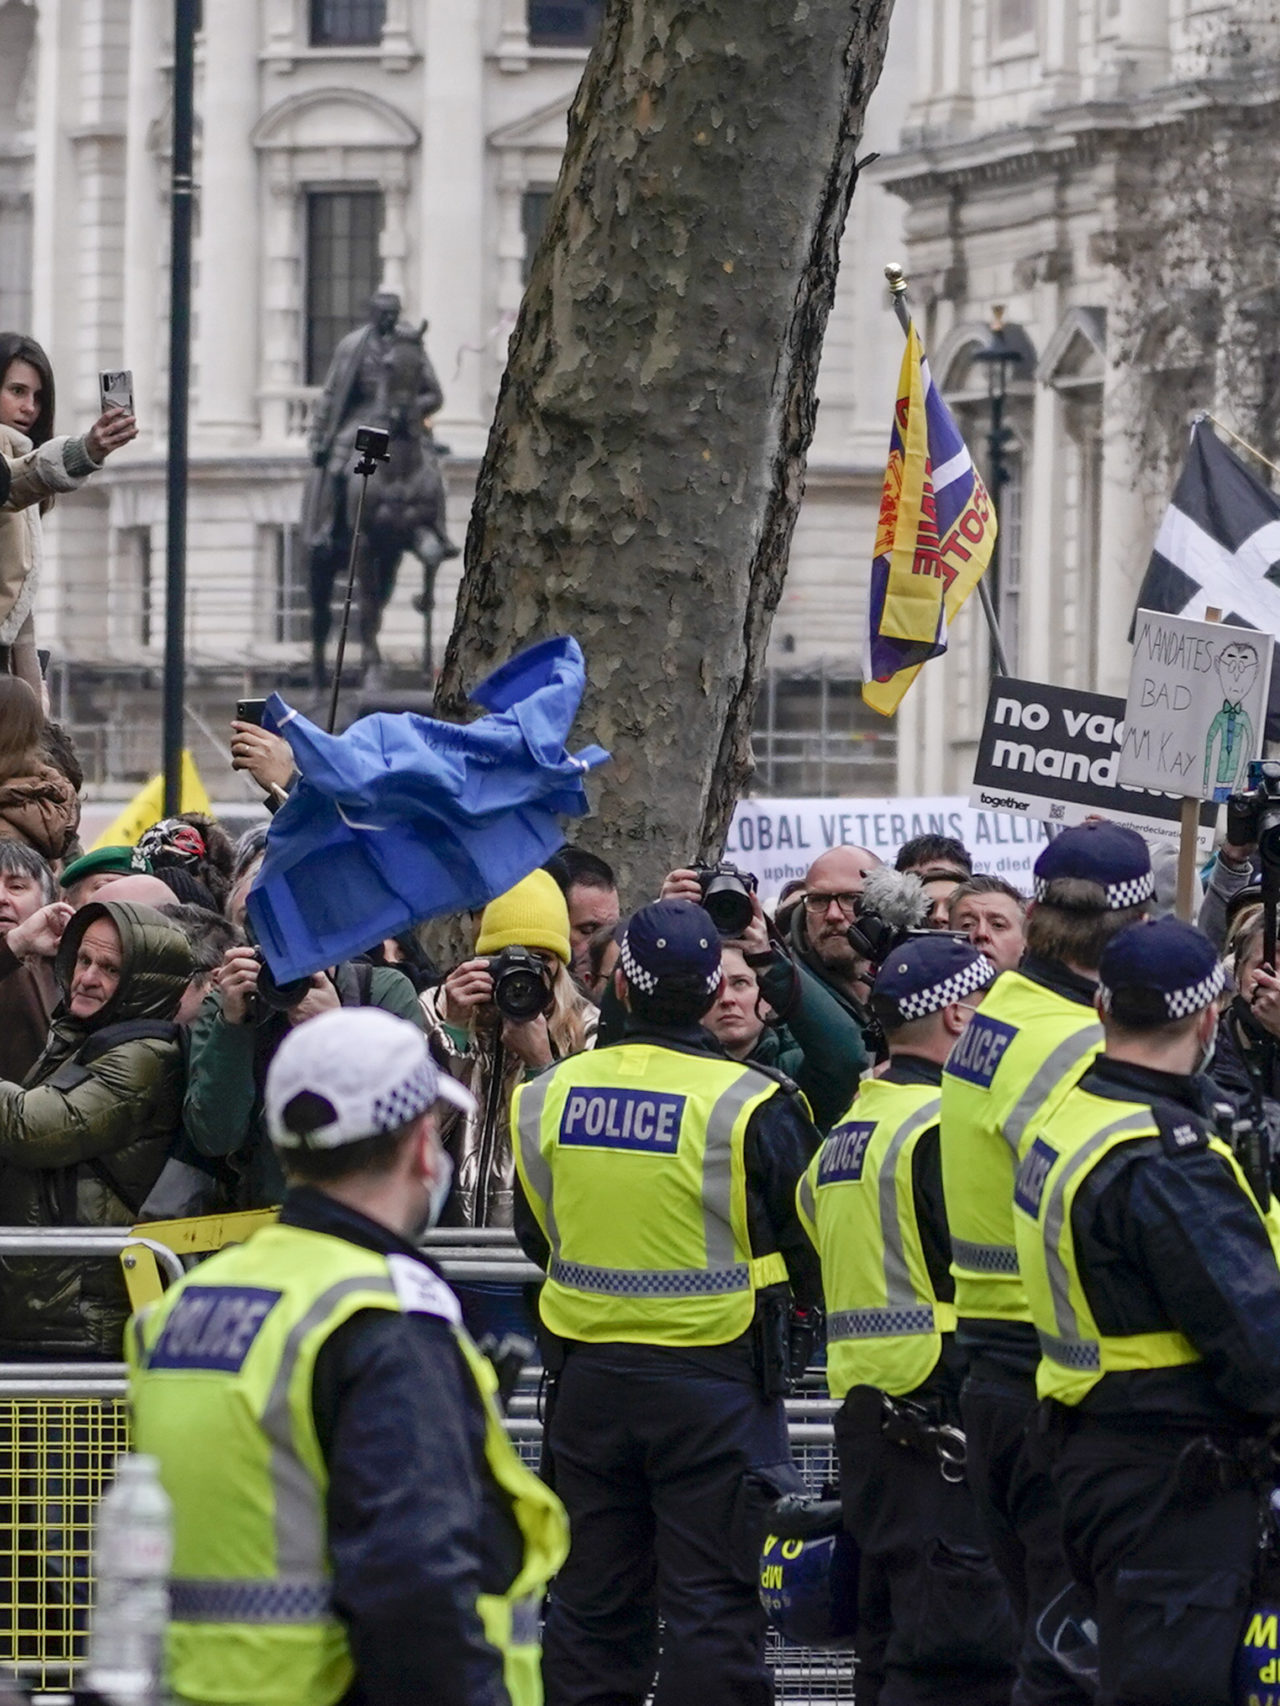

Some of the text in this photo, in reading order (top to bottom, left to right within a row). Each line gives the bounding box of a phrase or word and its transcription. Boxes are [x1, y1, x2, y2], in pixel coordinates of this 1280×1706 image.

[1133, 623, 1215, 674] MANDATES
[1140, 678, 1192, 711] BAD
[993, 697, 1122, 744] no va
[980, 792, 1030, 812] together
[820, 812, 963, 848] VETERANS
[996, 857, 1031, 871] died
[564, 1096, 677, 1142] POLICE
[761, 1564, 783, 1590] MP
[1259, 1657, 1280, 1684] P
